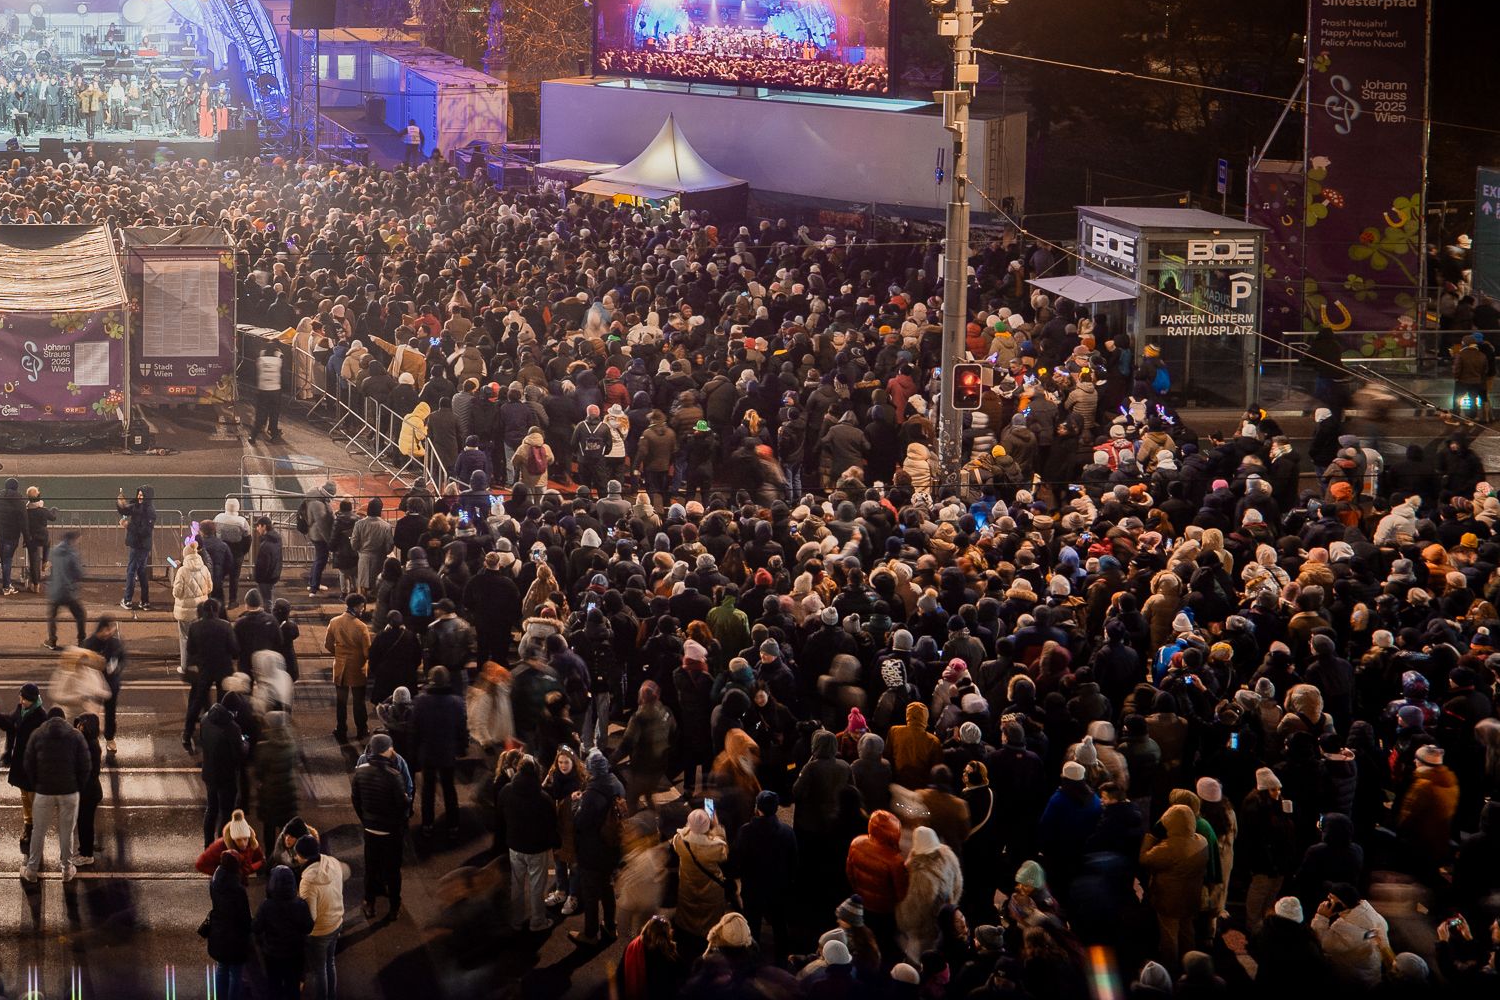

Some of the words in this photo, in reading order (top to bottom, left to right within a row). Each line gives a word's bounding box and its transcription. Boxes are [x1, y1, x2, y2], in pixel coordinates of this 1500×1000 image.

[1321, 19, 1346, 27] Prosit
[1348, 19, 1388, 29] Neujahr!
[1321, 29, 1351, 39] Happy
[1352, 30, 1374, 38] New
[1376, 30, 1399, 38] Year!
[1320, 38, 1345, 47] Felice
[1346, 39, 1372, 48] Anno
[1373, 40, 1407, 48] Nuovo!
[1361, 79, 1408, 90] Johann
[1361, 89, 1408, 100] Strauss
[1374, 101, 1407, 112] 2025
[1374, 112, 1406, 123] Wien
[1483, 184, 1500, 198] EXI
[1092, 226, 1135, 263] BOE
[1188, 239, 1255, 260] BOE
[1231, 281, 1252, 308] P
[1160, 315, 1205, 325] PARKEN
[1208, 314, 1254, 324] UNTERM
[1167, 326, 1254, 336] RATHAUSPLATZ
